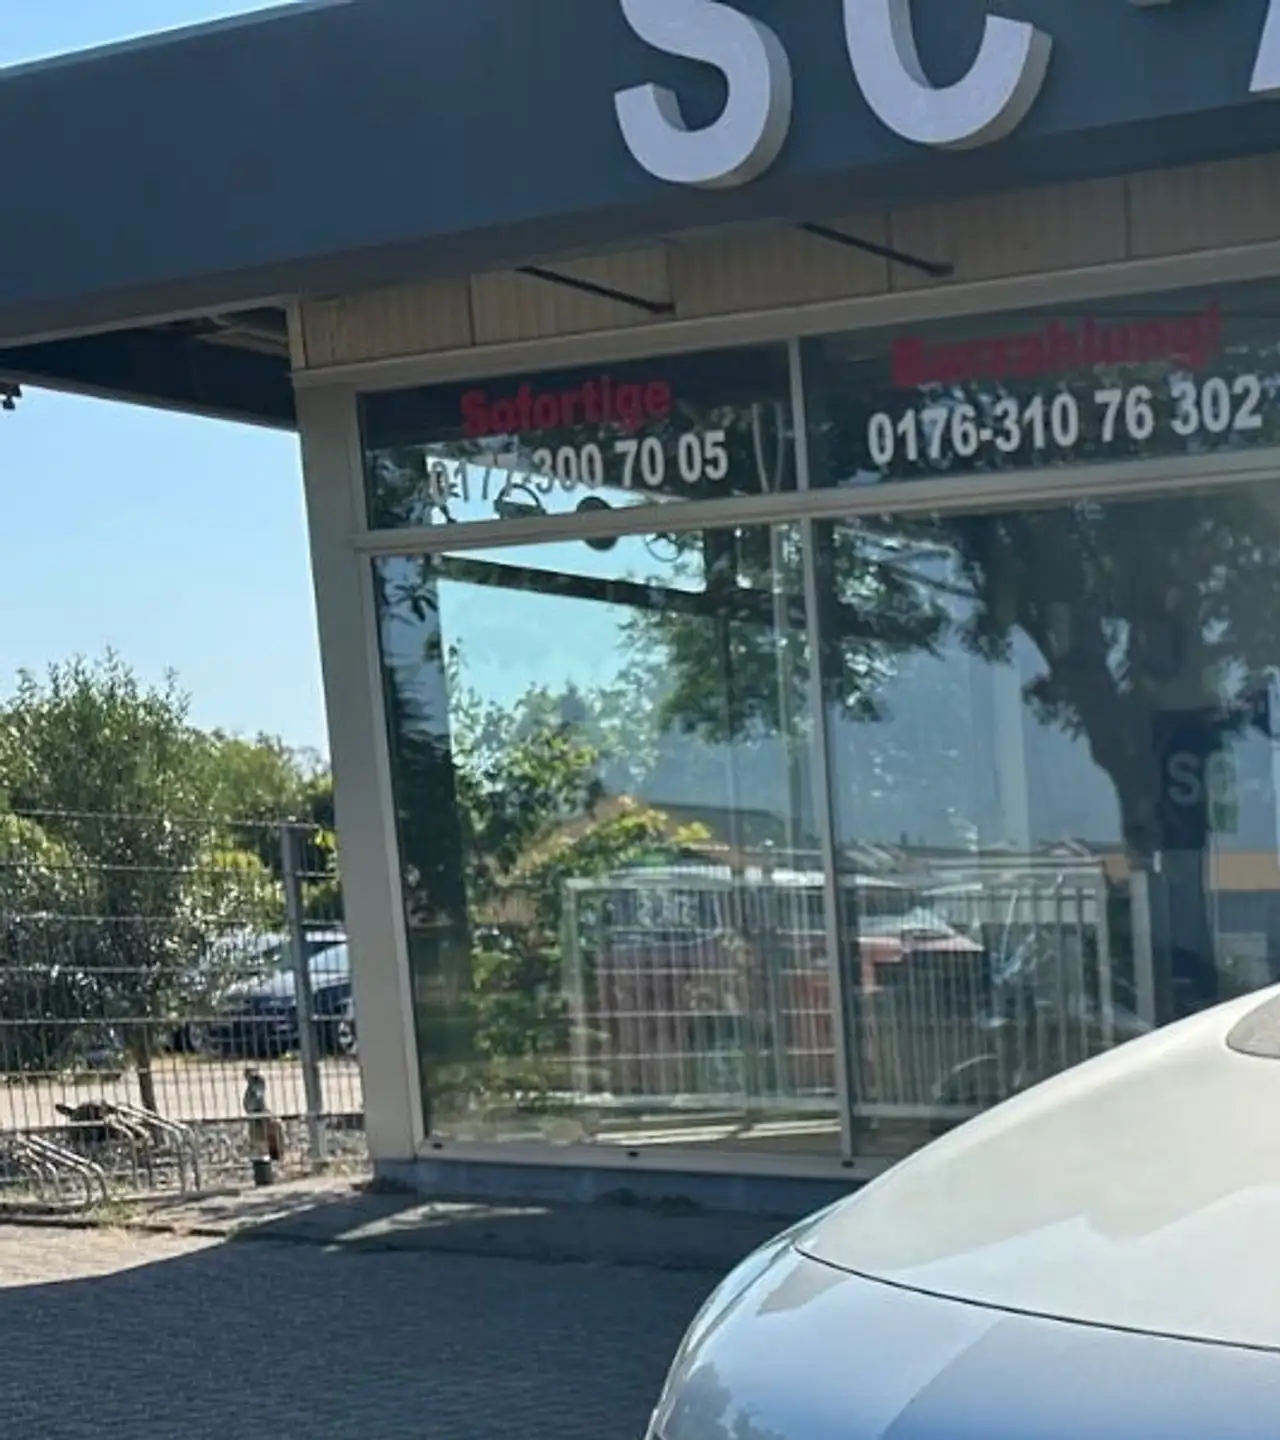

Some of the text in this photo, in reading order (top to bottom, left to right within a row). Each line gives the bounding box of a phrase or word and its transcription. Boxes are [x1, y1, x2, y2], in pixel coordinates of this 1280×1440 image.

[459, 375, 672, 437] Sofortige
[867, 374, 1263, 466] 0176-310 76 302
[615, 436, 665, 488] 70
[677, 429, 729, 482] 05
